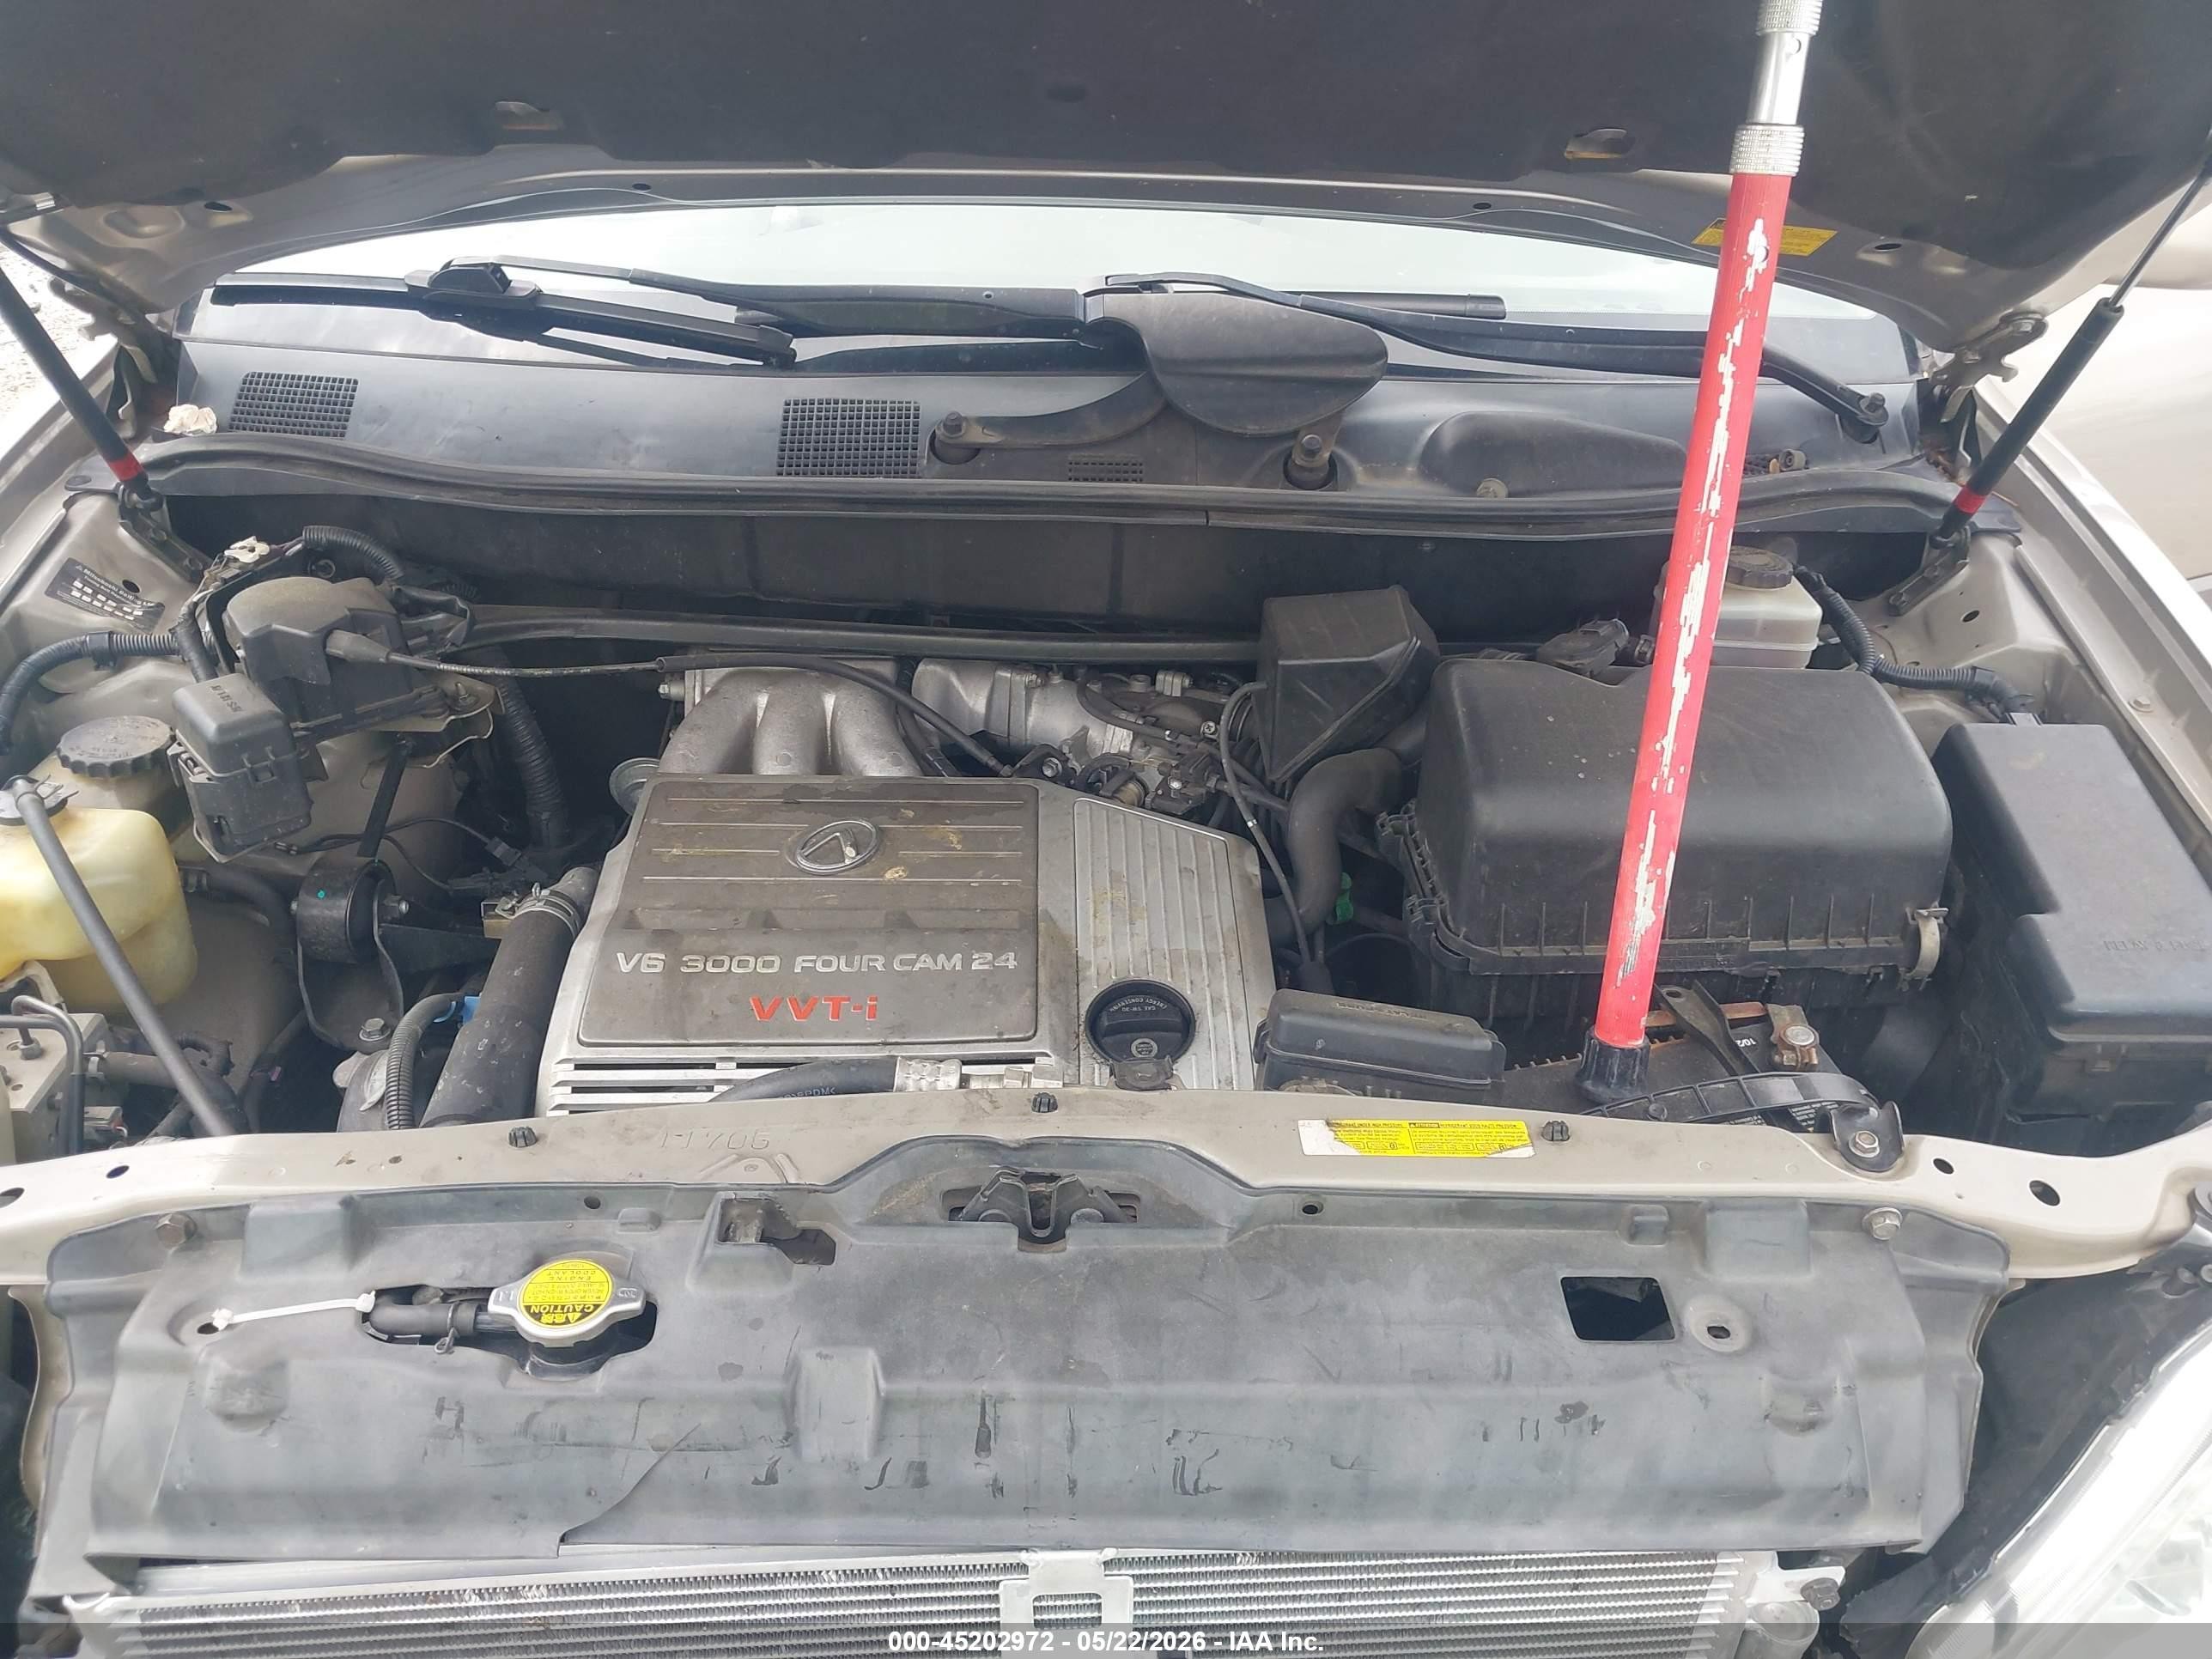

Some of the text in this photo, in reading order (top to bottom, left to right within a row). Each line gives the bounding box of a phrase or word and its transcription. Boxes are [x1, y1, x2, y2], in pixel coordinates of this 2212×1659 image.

[617, 951, 1018, 973] V6 3000 FOUR CAM 24
[750, 994, 879, 1022] VVT-i
[530, 1304, 594, 1314] CAUTION
